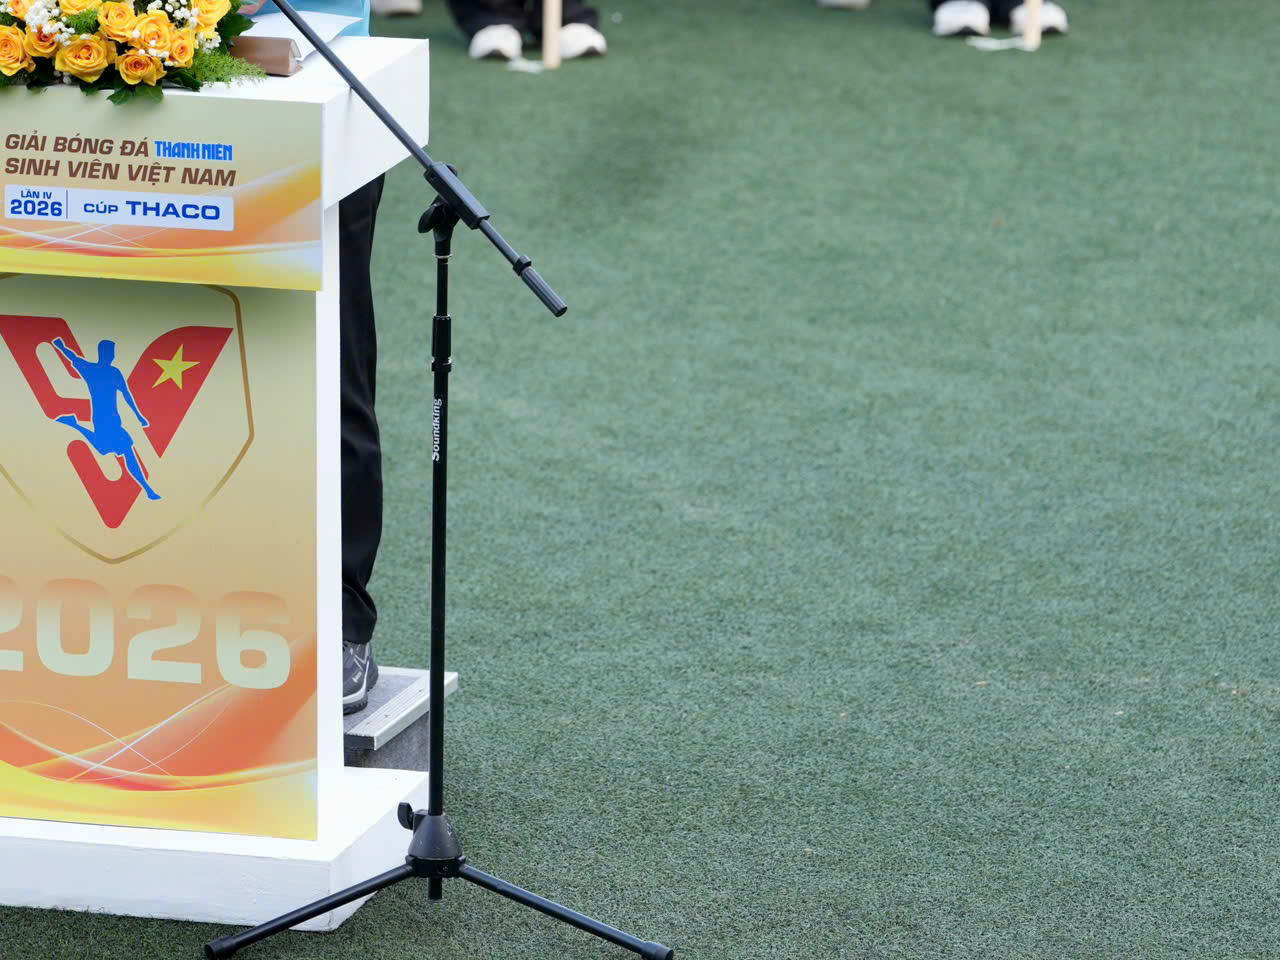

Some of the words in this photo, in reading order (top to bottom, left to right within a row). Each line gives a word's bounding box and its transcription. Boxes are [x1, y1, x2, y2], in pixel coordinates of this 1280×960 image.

[4, 130, 46, 151] GIẢI
[53, 133, 114, 156] BÓNG
[119, 137, 149, 157] ĐÁ
[4, 157, 60, 177] SINH
[68, 158, 120, 180] VIÊN
[127, 161, 176, 186] VIỆT
[180, 167, 237, 187] NAM
[20, 189, 40, 199] LẦN
[42, 191, 52, 200] IV
[10, 199, 63, 217] 2026
[83, 201, 119, 214] CÚP
[125, 200, 220, 220] THACO
[431, 398, 443, 462] Soundking
